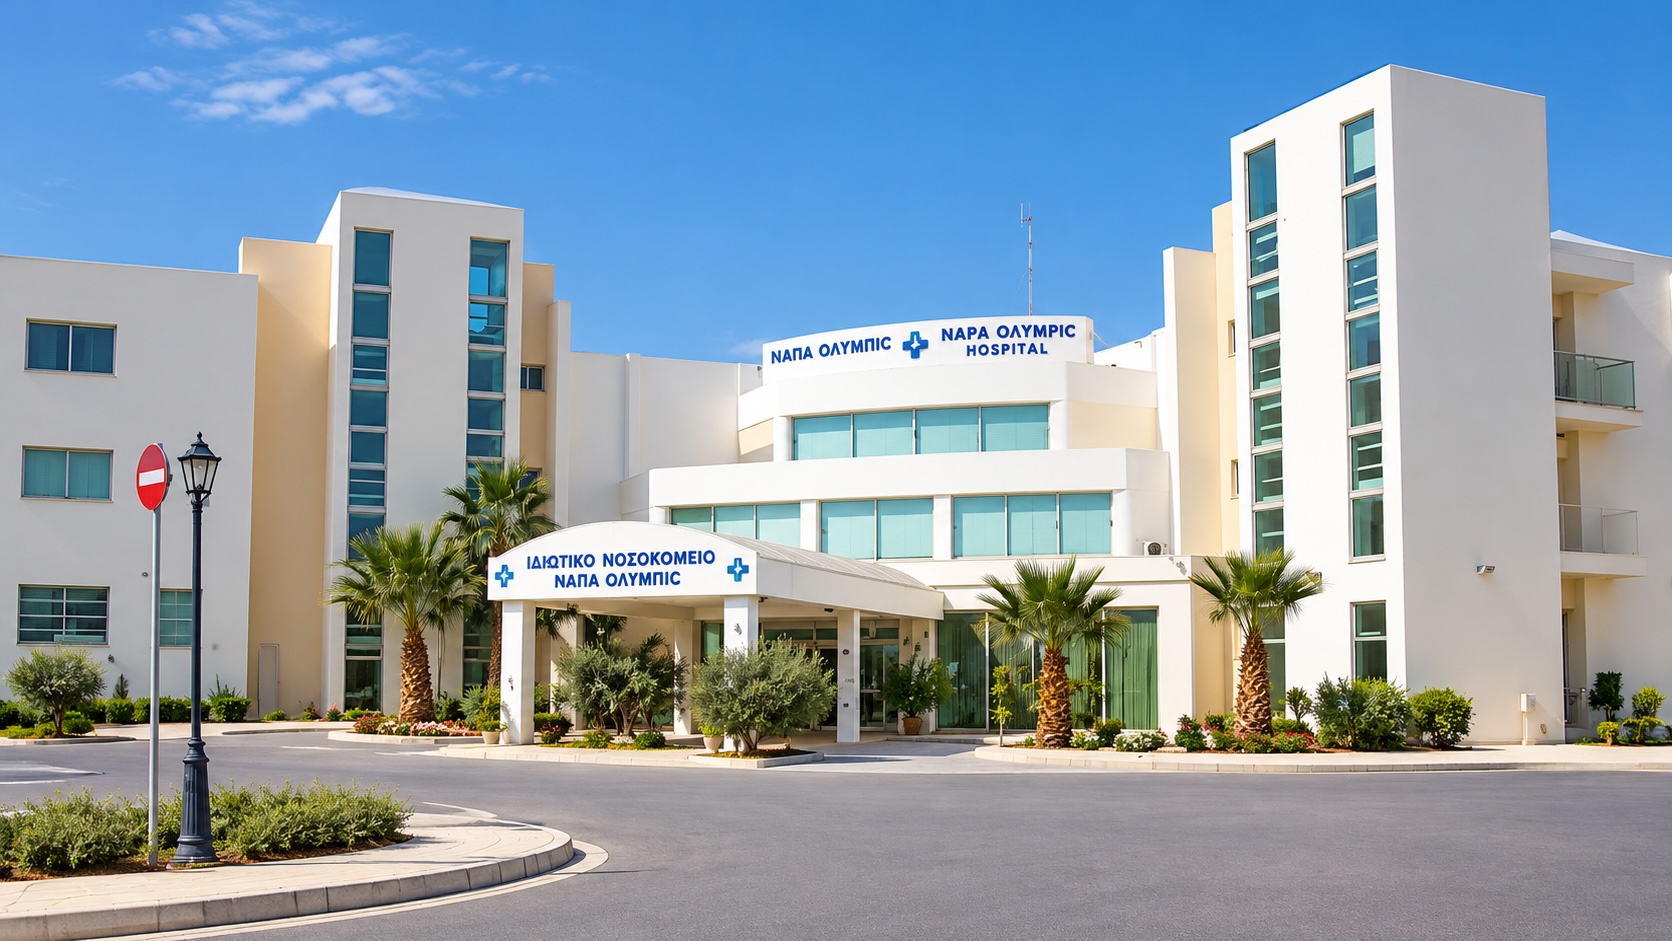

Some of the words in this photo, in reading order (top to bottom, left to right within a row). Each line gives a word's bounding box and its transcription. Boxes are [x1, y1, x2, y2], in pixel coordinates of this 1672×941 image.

[941, 325, 990, 342] NAPA
[771, 346, 814, 364] ΝΑΠΑ
[966, 342, 1048, 357] HOSPITAL
[602, 549, 716, 568] ΝΟΣΟΚΟΜΕΙΟ
[554, 573, 600, 589] ΝΑΠΑ
